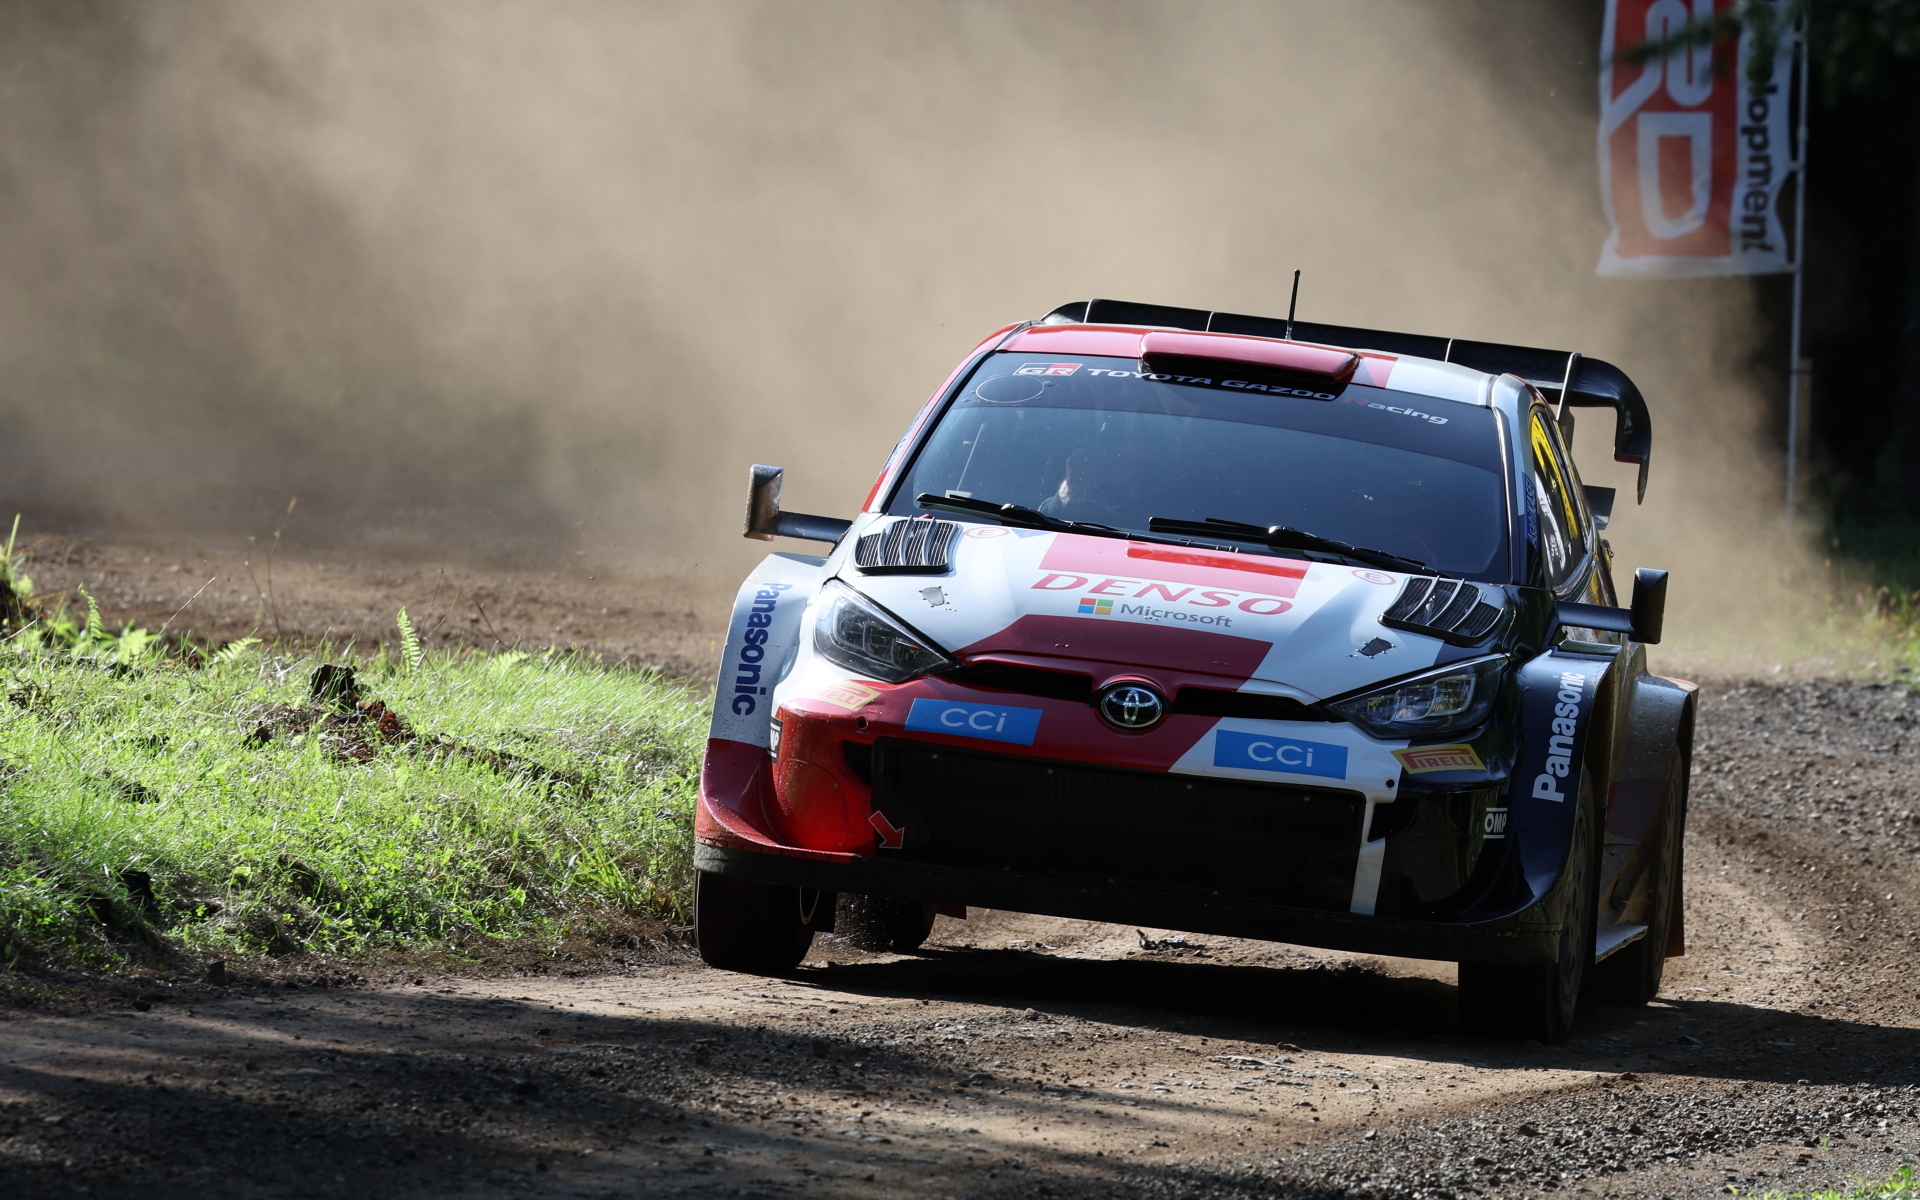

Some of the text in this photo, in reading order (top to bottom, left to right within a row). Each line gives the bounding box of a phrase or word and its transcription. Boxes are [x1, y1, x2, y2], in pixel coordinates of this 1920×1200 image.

[1086, 367, 1212, 385] TOYOTA
[1220, 378, 1337, 401] GAZOO
[1343, 396, 1449, 425] Racing
[1030, 572, 1294, 616] DENSO
[1120, 603, 1233, 628] Microsoft
[731, 582, 793, 716] Panasonic
[940, 707, 1008, 733] CCi
[1531, 671, 1586, 803] Panasonic
[1247, 741, 1314, 769] CCi
[1399, 747, 1478, 770] PIRELLI
[1484, 812, 1507, 834] OMP
